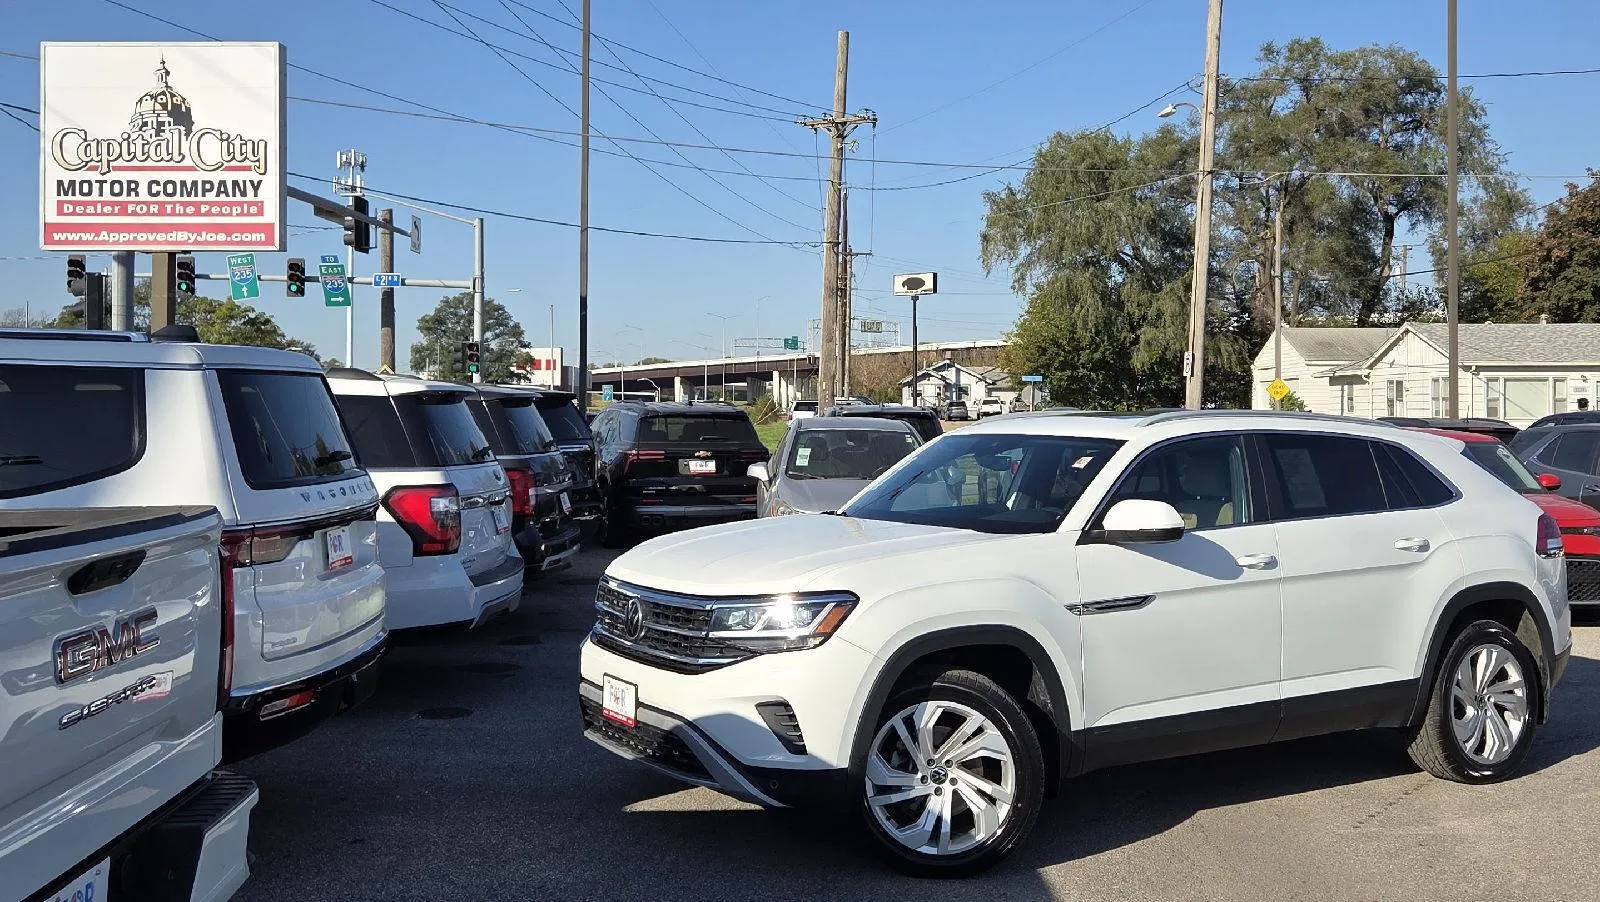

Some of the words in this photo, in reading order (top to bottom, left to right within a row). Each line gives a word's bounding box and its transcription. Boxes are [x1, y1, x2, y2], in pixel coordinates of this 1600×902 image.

[51, 127, 186, 175] Capital
[189, 127, 267, 175] City
[56, 179, 140, 197] MOTOR
[147, 179, 263, 197] COMPANY
[63, 203, 121, 214] Dealer
[127, 204, 160, 214] FOR
[165, 203, 195, 214] The
[200, 203, 259, 216] People
[52, 230, 266, 243] www.ApprovedByJoe.com
[235, 269, 253, 281] 235
[321, 266, 342, 274] EAST
[325, 279, 344, 288] 235
[53, 604, 160, 686] GMC
